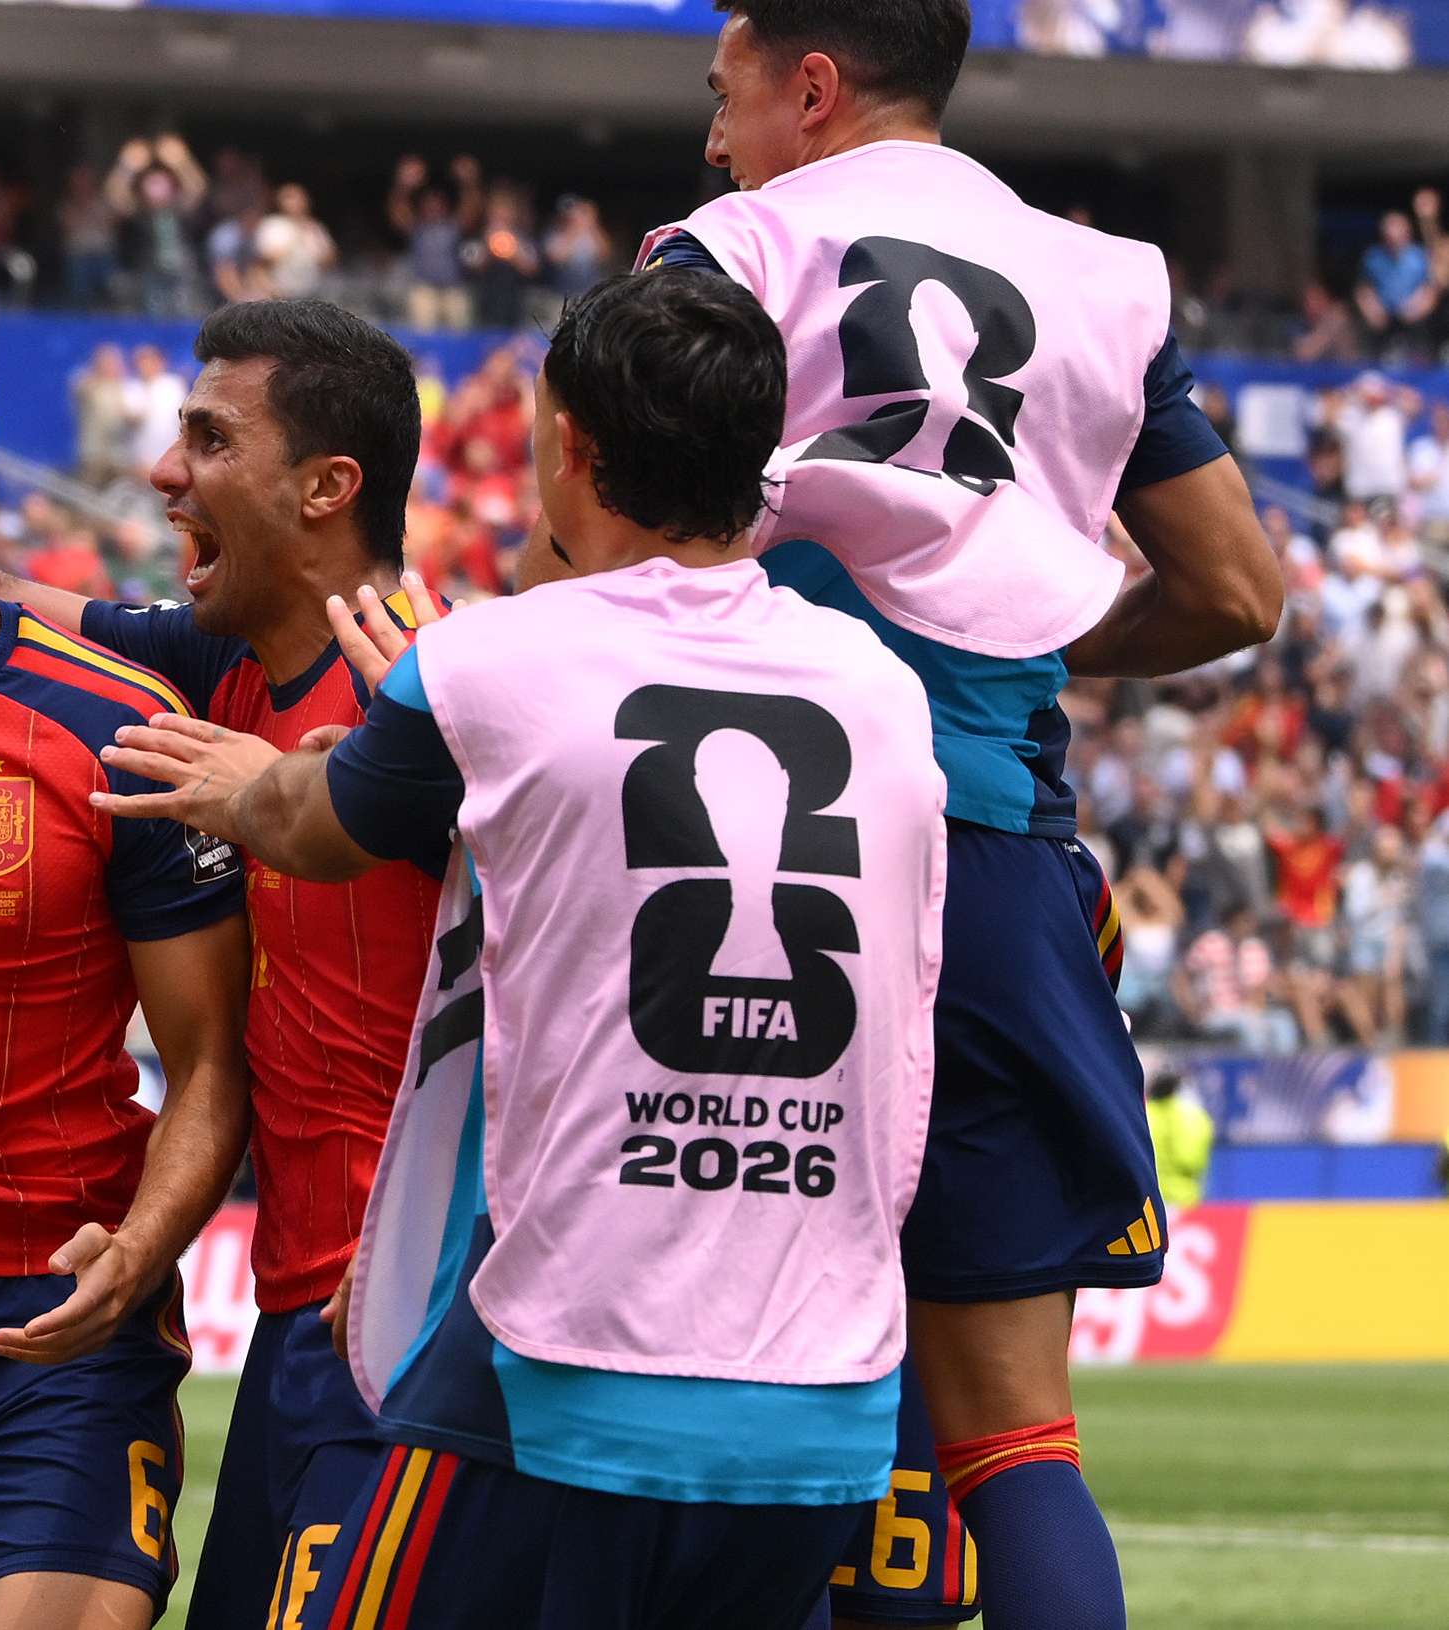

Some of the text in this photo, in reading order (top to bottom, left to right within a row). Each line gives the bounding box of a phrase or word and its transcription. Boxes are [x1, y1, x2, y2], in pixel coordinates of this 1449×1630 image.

[702, 996, 798, 1041] FIFA
[625, 1092, 844, 1133] WORLD CUP
[619, 1134, 836, 1198] 2026
[127, 1440, 168, 1561] 6
[829, 1469, 931, 1589] 6
